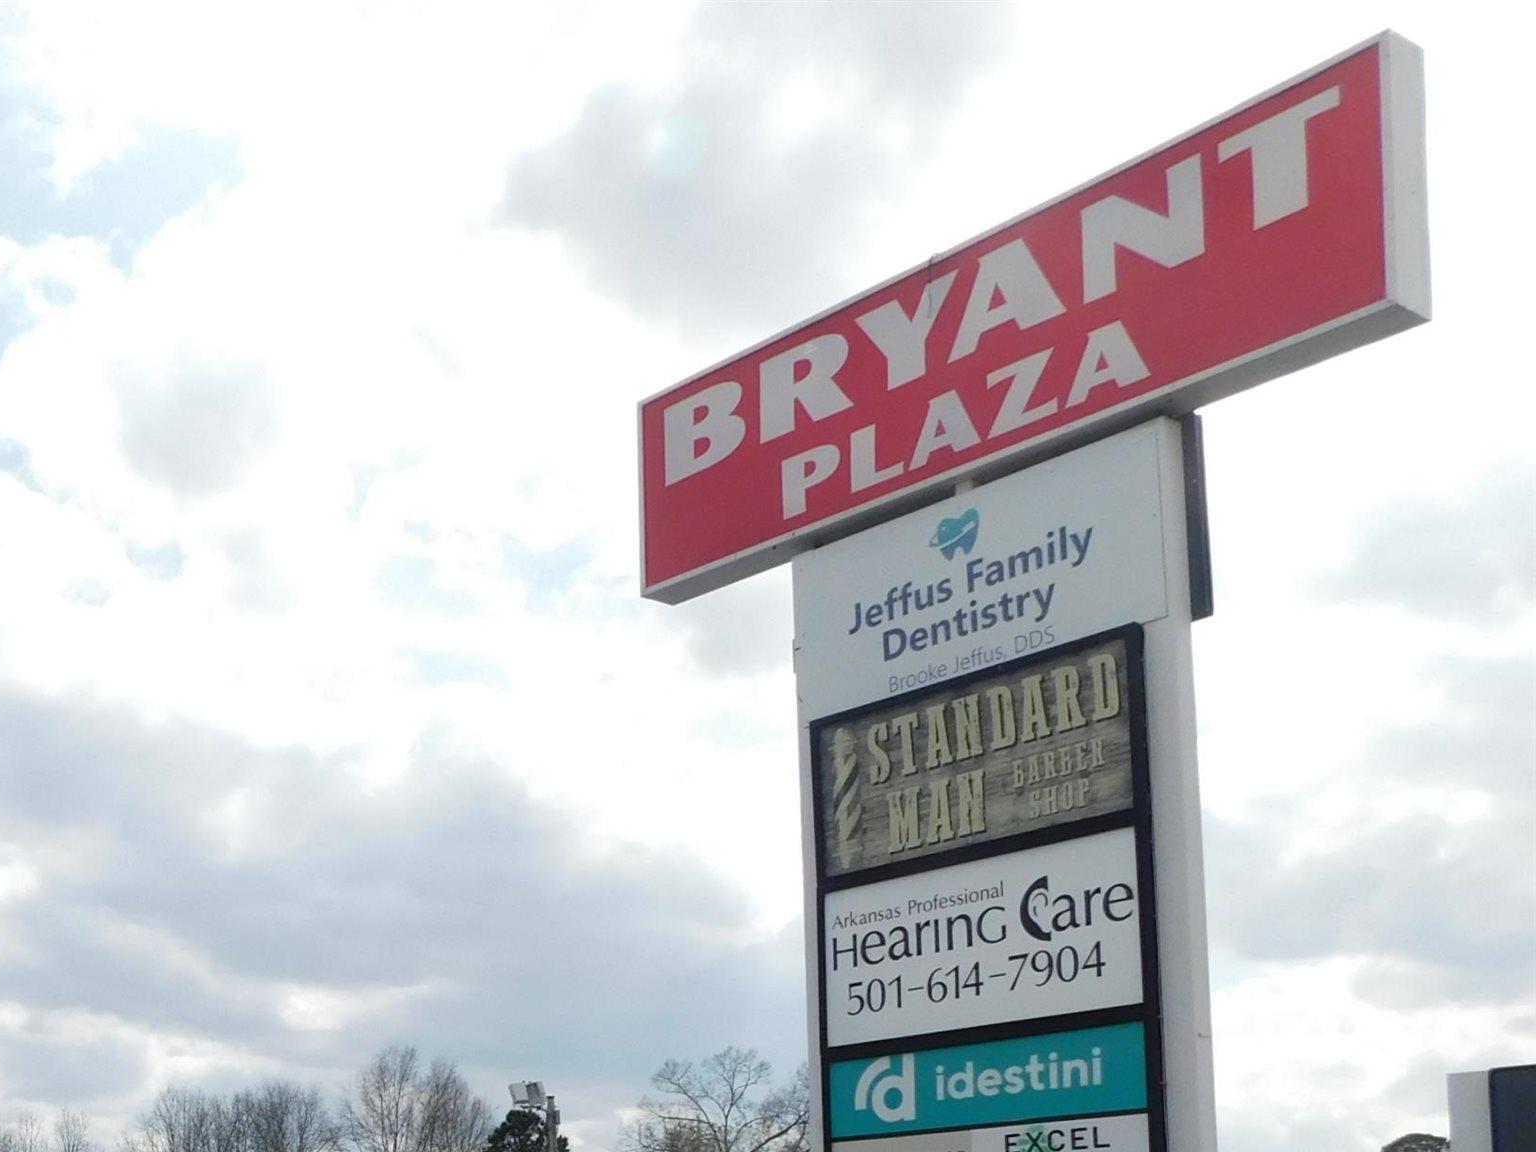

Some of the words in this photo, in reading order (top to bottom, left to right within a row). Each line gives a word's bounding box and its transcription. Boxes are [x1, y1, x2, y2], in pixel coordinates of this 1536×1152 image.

[665, 85, 1341, 487] BRYANT
[781, 320, 1151, 521] PLAZA
[848, 577, 953, 635] Jeffus
[966, 525, 1093, 593] Family
[882, 583, 1055, 662] Dentistry
[888, 663, 947, 694] Brooke
[952, 645, 1007, 676] Jeffus,
[1014, 625, 1056, 654] DDS
[867, 653, 1121, 786] STANDARD
[1012, 737, 1106, 788] BARBER
[1029, 778, 1091, 819] SHOP
[886, 768, 987, 855] MAN
[832, 905, 902, 931] Arkansas
[907, 880, 1005, 916] Professional
[1019, 875, 1135, 942] Care
[846, 941, 1107, 1016] 501-614-7904
[935, 1047, 1103, 1101] idestini
